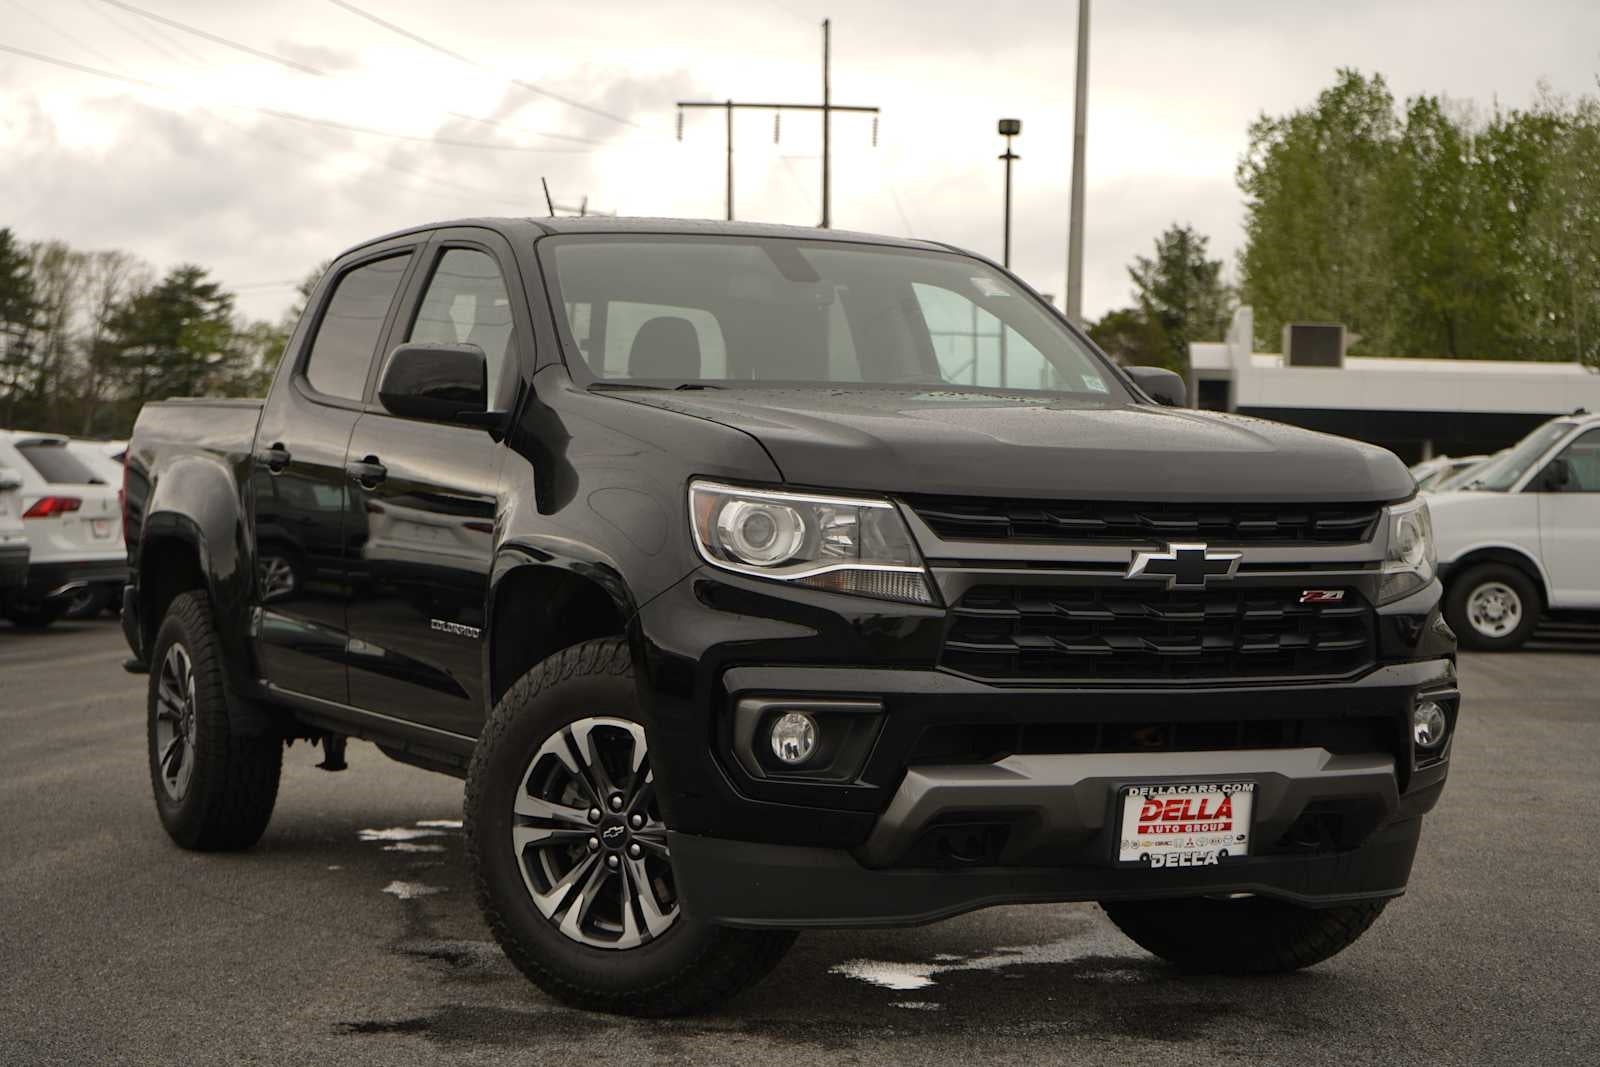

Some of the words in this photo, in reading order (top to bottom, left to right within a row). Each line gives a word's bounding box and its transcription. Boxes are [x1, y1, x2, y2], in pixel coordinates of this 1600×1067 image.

[1299, 590, 1345, 602] Z71
[430, 618, 480, 639] COLORADO
[1129, 784, 1254, 796] DELLACARS.COM
[1139, 797, 1232, 821] DELLA
[1147, 825, 1180, 834] AUTO
[1185, 823, 1225, 833] GROUP
[1151, 852, 1219, 868] DELLA
